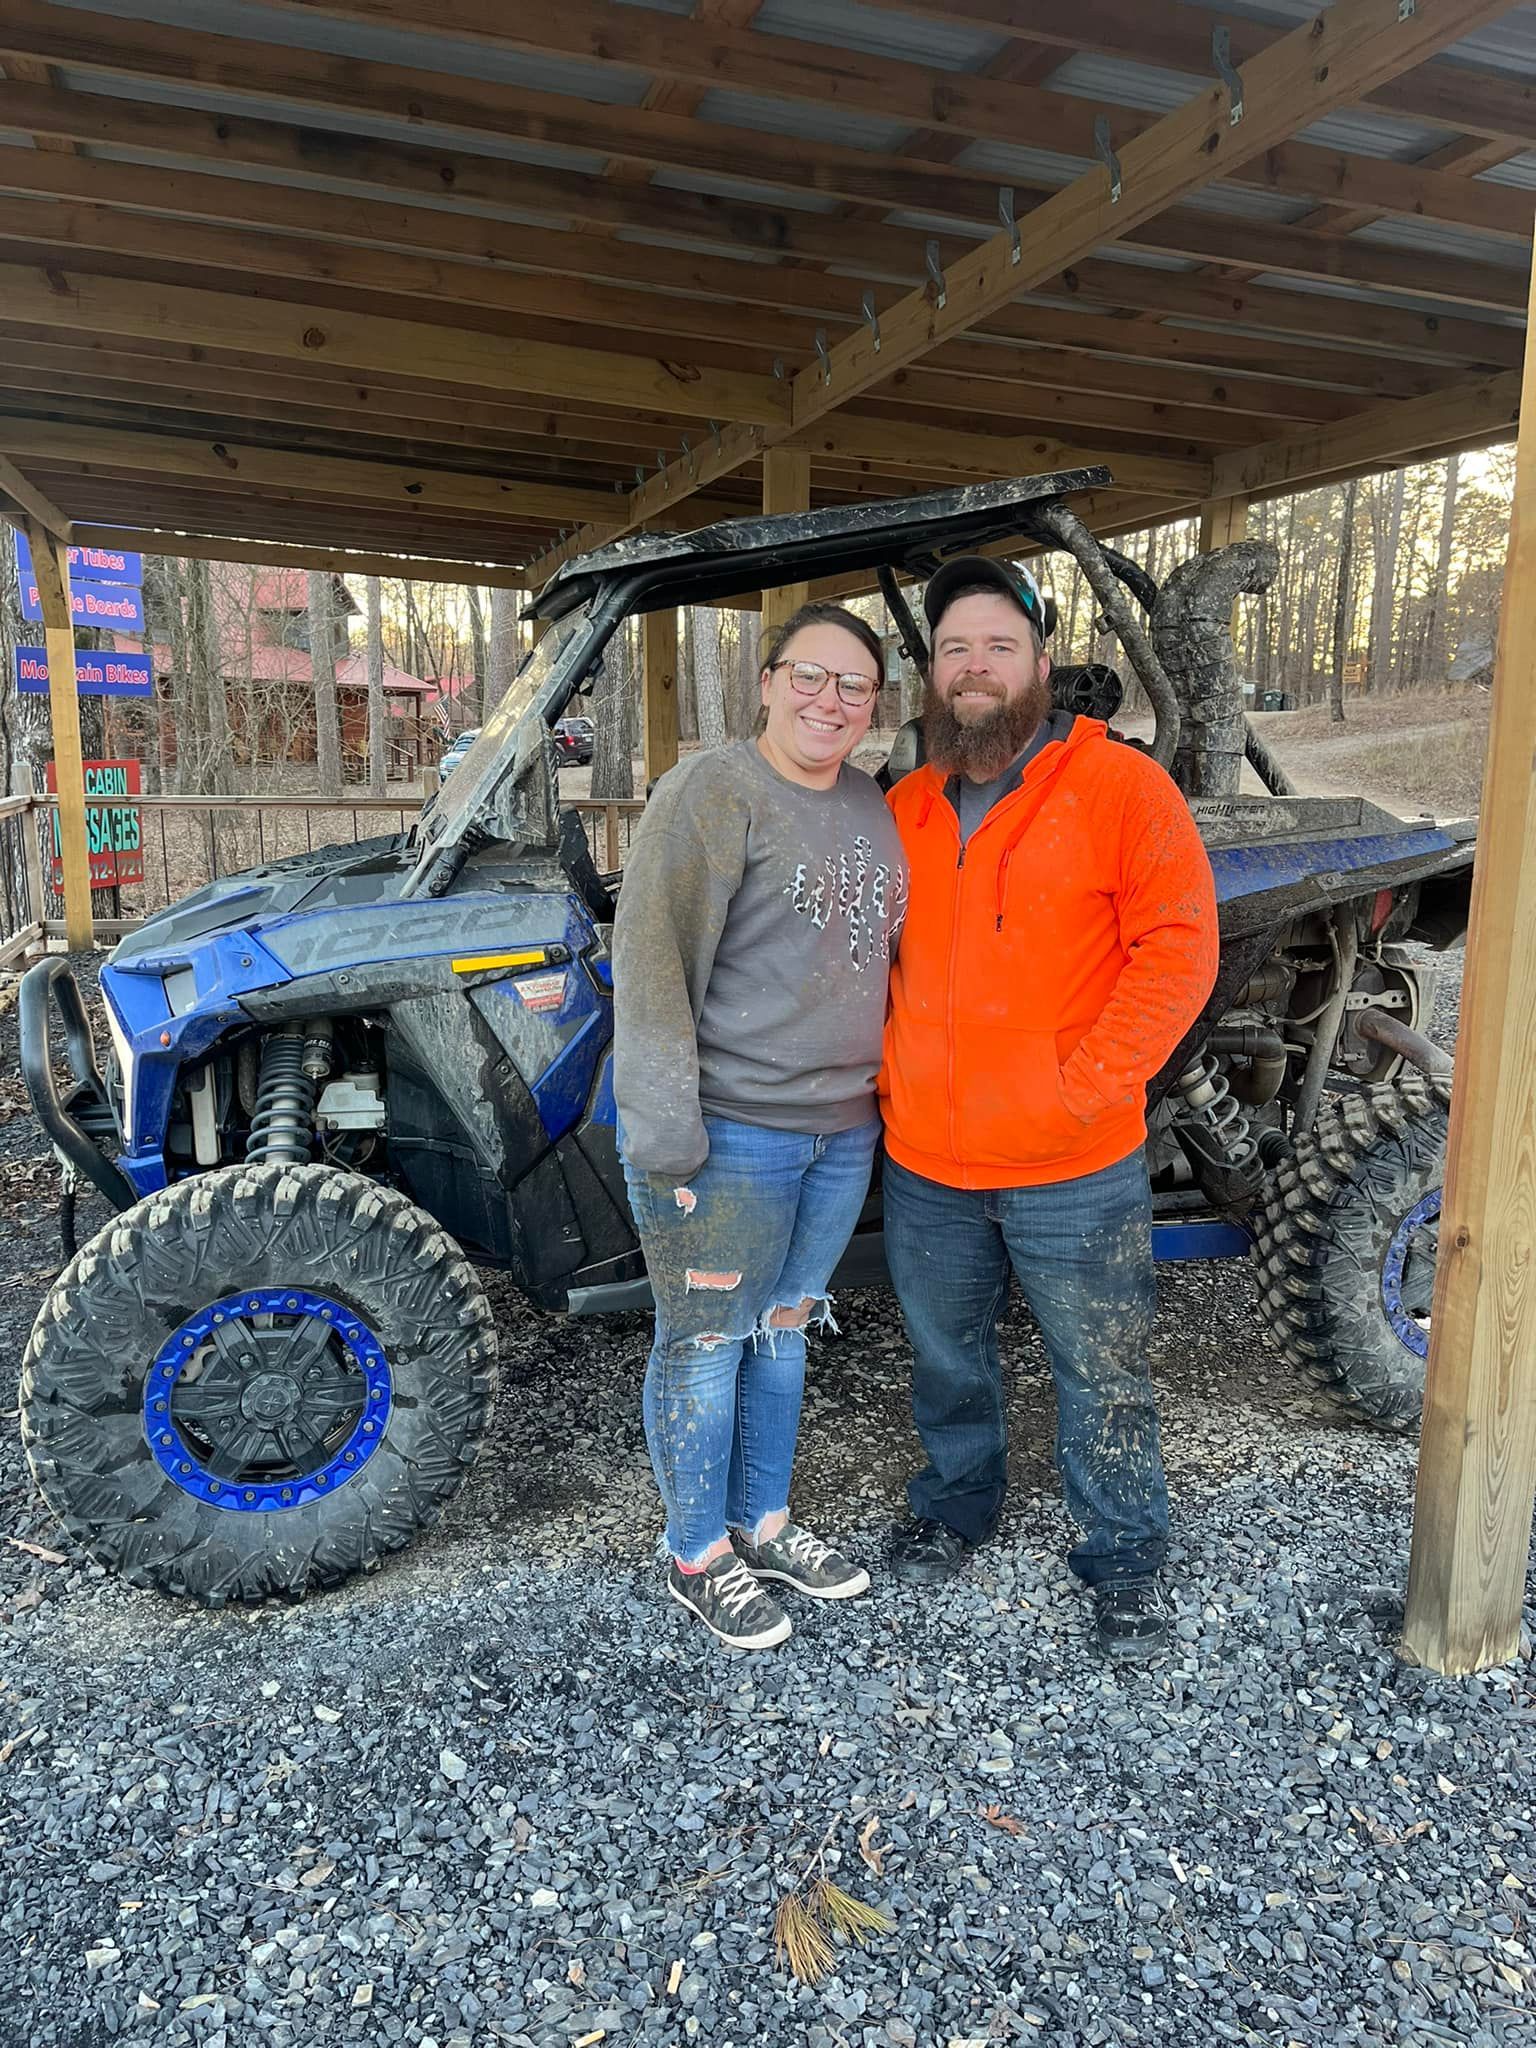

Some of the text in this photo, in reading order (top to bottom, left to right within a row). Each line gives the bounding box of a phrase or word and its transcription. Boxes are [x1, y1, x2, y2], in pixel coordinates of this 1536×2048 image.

[80, 547, 126, 570] Tubes
[29, 586, 137, 618] Ple Boards
[20, 659, 149, 684] Moain Bikes
[85, 768, 127, 795] CABIN
[53, 808, 140, 858] MSAGES
